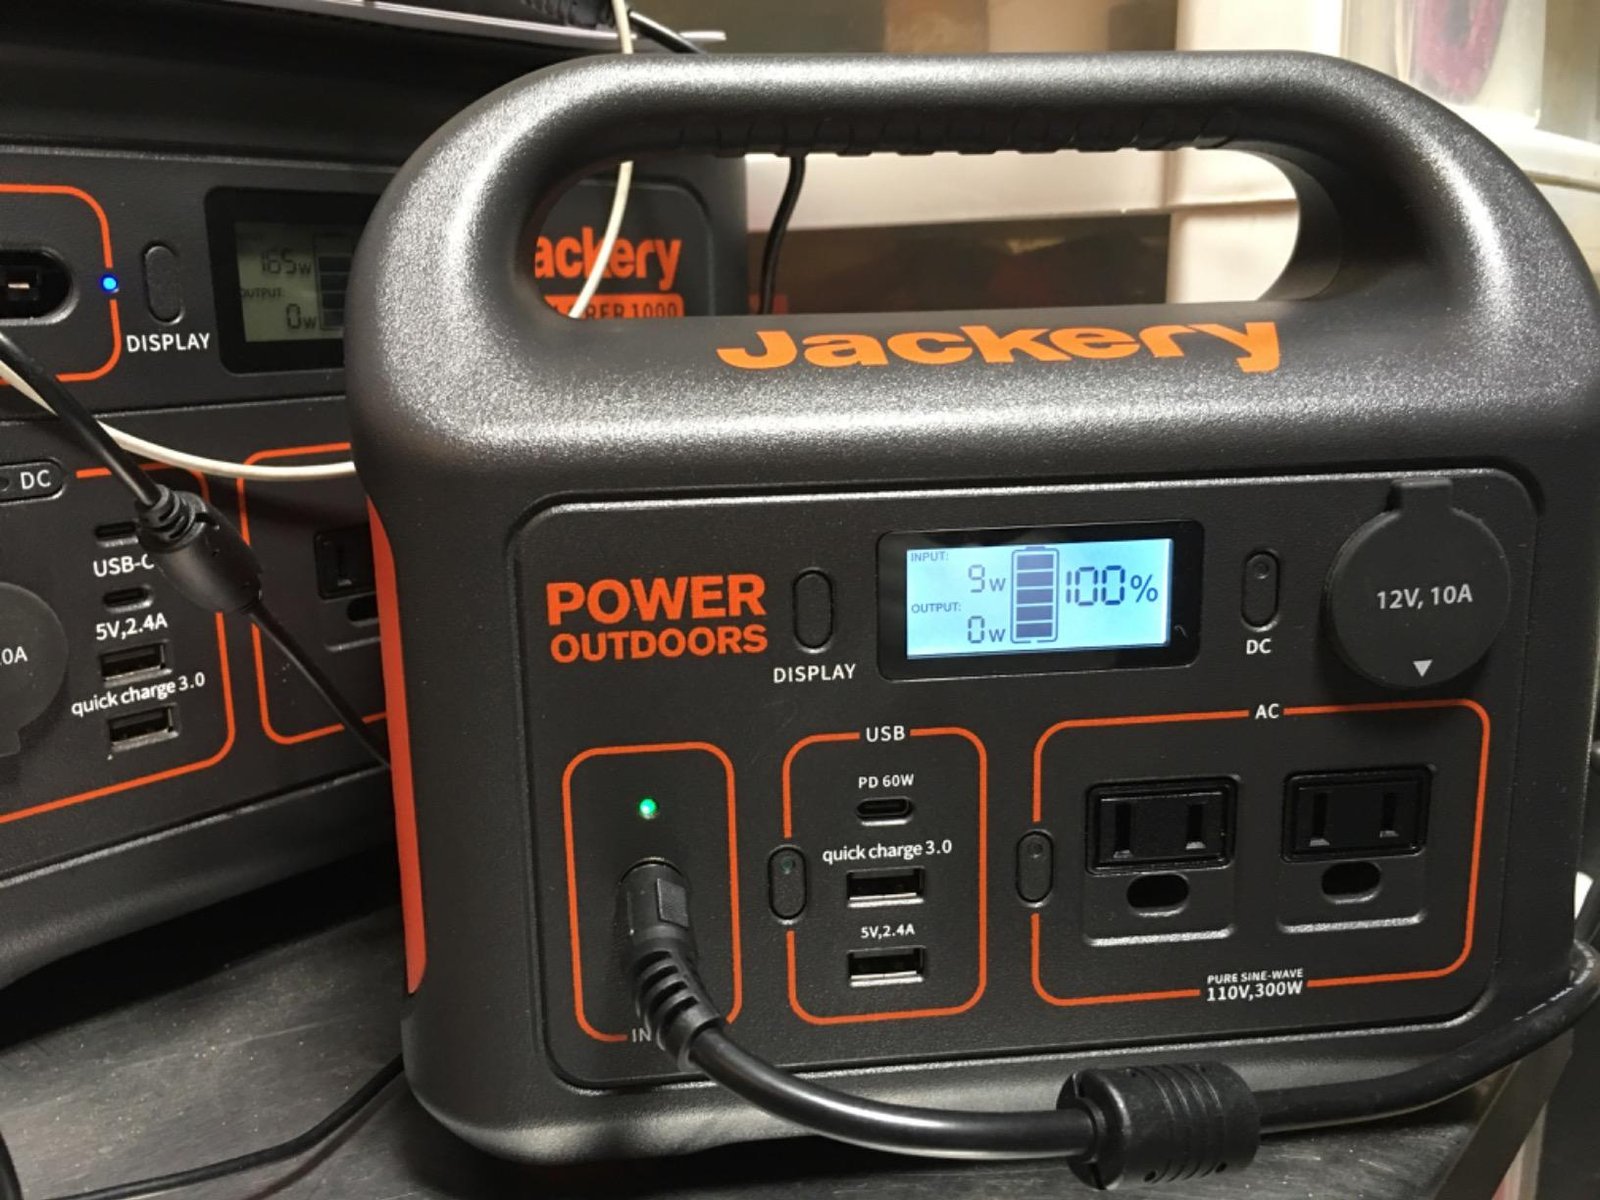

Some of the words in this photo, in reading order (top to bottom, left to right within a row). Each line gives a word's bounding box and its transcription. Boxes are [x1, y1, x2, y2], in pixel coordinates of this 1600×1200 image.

[534, 226, 682, 291] ackery
[126, 332, 210, 353] DISPLAY
[716, 321, 1281, 373] Jackery
[19, 470, 52, 490] DC
[1065, 564, 1159, 607] 100%
[546, 573, 768, 626] POWER
[550, 623, 769, 664] OUTDOORS
[1245, 638, 1272, 655] DC
[0, 646, 29, 666] 0A
[773, 663, 857, 684] DISPLAY
[71, 690, 119, 718] quick
[120, 681, 177, 704] charge
[178, 671, 206, 690] 3.0
[1254, 703, 1280, 720] AC
[865, 725, 906, 742] USB
[858, 776, 878, 789] PD
[882, 773, 915, 788] 60W
[822, 845, 866, 865] quick
[868, 842, 922, 861] charge
[925, 839, 953, 856] 3.0
[1206, 973, 1238, 985] PURE
